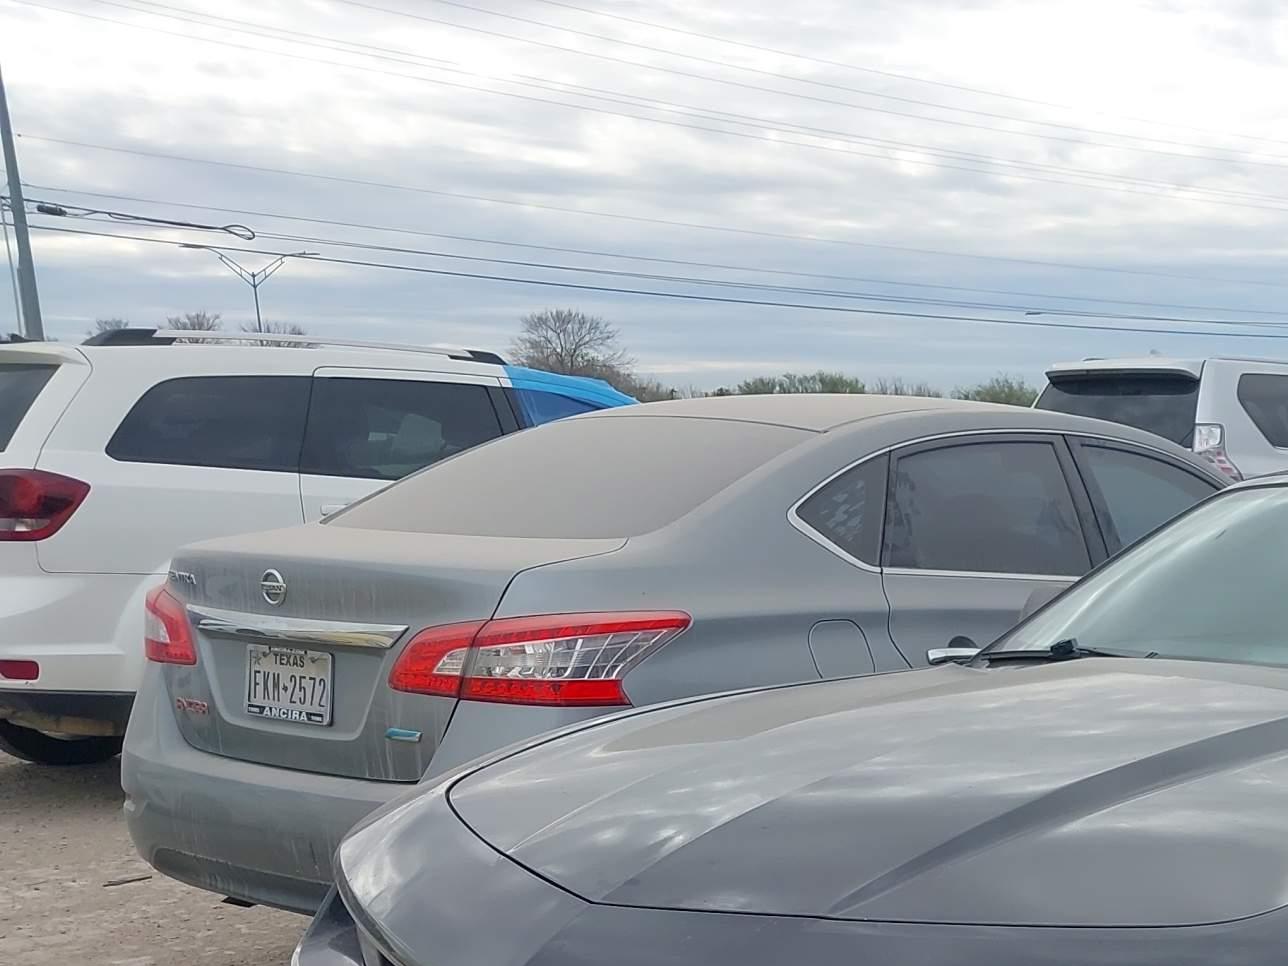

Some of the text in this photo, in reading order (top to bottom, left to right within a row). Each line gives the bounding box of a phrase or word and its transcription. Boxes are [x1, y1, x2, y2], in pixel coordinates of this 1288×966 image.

[273, 653, 305, 669] TEXAS
[289, 674, 327, 708] 2572
[262, 706, 308, 721] ANCIRA
